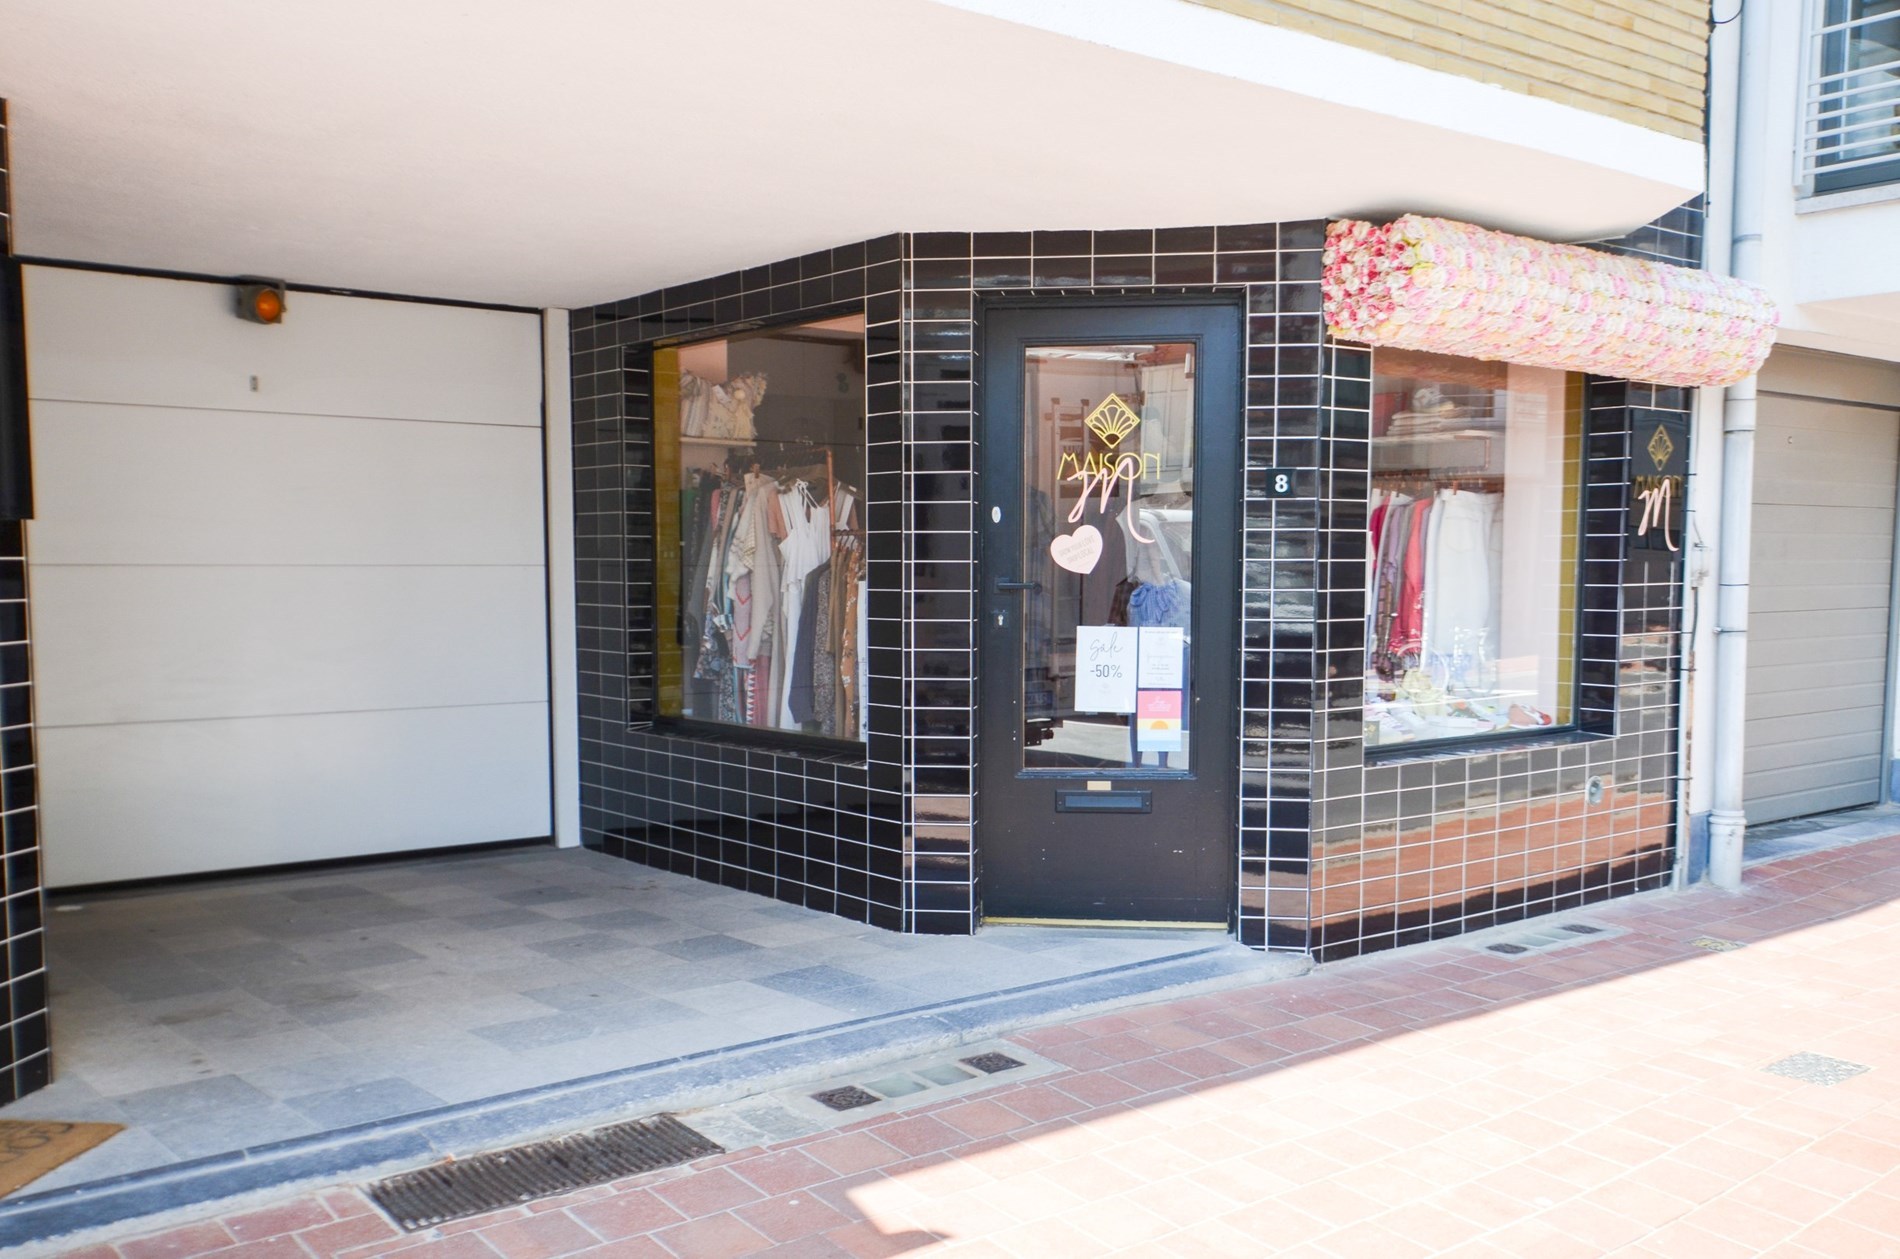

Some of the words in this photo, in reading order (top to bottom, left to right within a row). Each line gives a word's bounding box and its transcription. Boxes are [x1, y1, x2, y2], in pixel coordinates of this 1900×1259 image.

[1057, 452, 1160, 481] MAISON
[1275, 474, 1289, 493] 8
[1638, 479, 1679, 551] M
[1089, 664, 1123, 679] -50%
